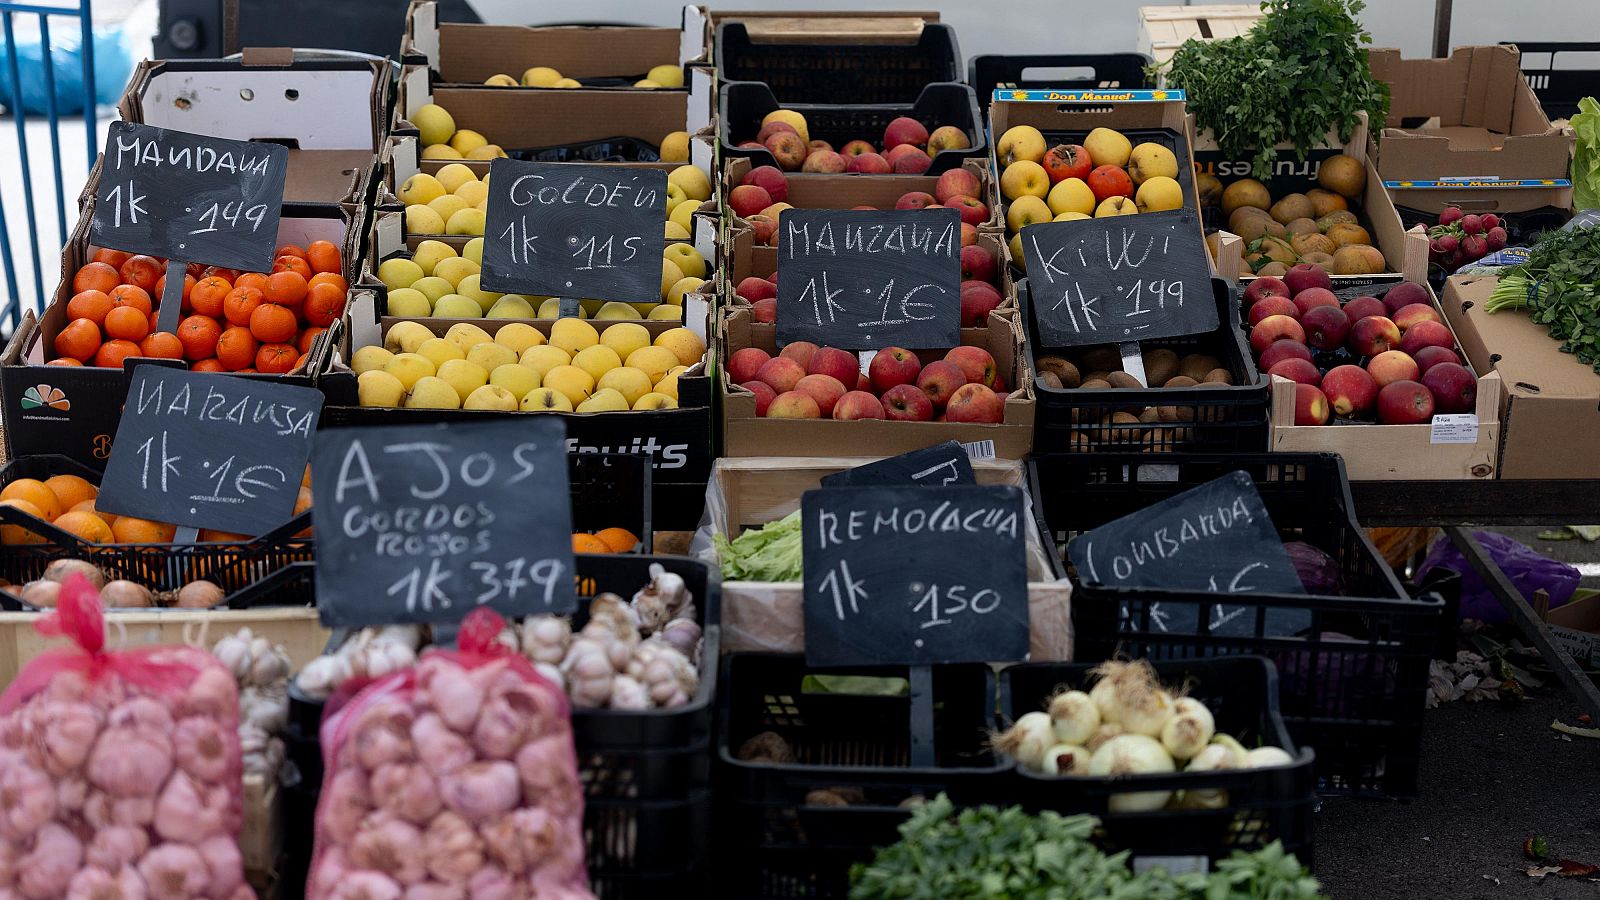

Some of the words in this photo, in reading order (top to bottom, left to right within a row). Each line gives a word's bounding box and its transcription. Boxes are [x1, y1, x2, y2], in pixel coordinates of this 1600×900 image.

[1049, 92, 1076, 100] Don
[1080, 92, 1131, 100] Manuel
[788, 220, 954, 259] MANZANA
[136, 378, 314, 439] NARANJA
[335, 439, 537, 503] AJOS
[343, 503, 497, 538] GORDOS
[819, 501, 1017, 549] REMOLACHA
[376, 530, 492, 556] ROJOS
